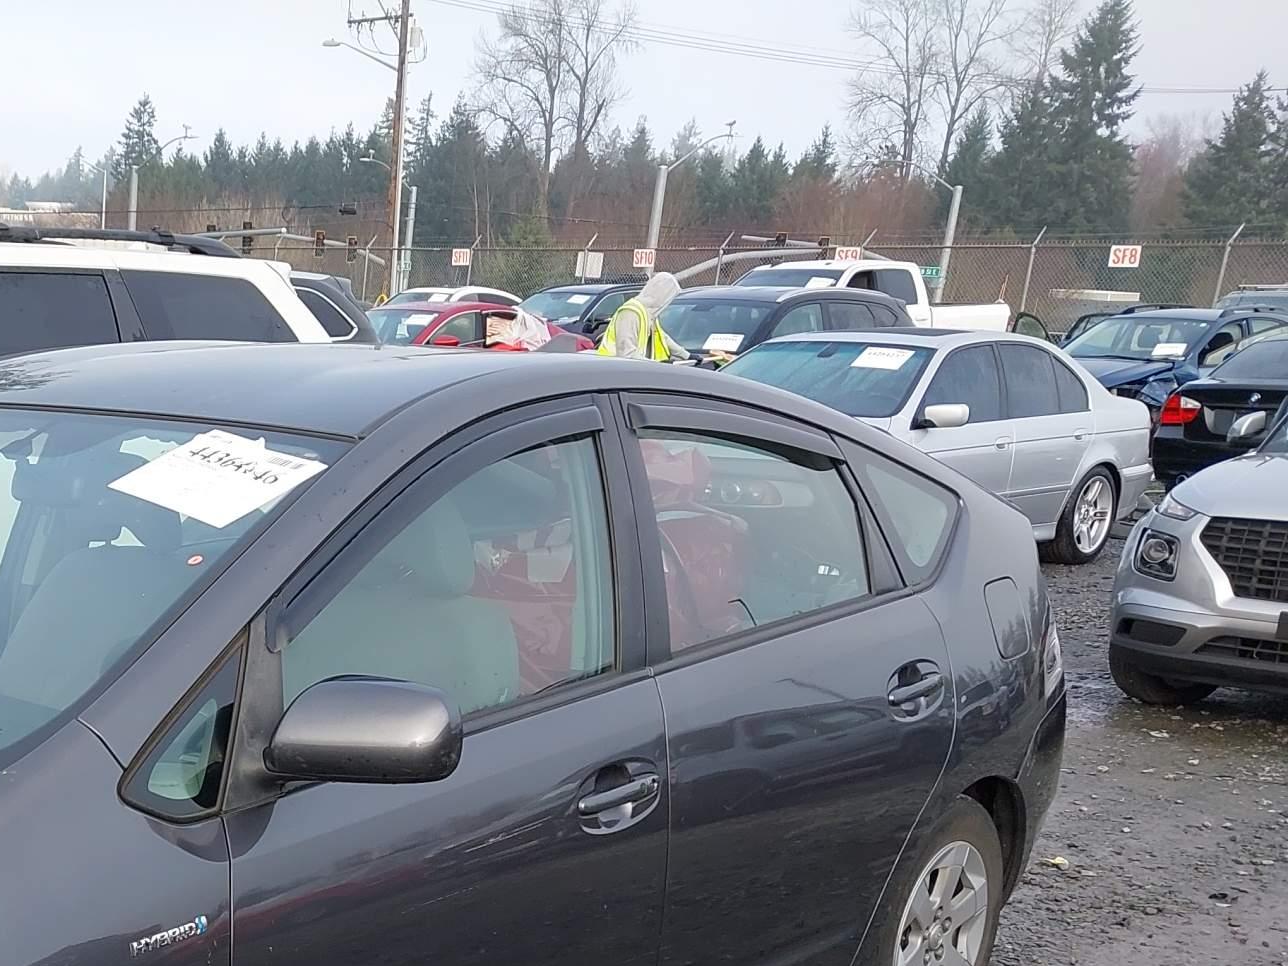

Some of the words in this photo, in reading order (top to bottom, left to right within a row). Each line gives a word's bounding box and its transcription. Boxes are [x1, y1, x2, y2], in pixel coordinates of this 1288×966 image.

[454, 250, 468, 263] SF11
[634, 250, 653, 265] SF10
[1112, 247, 1138, 265] SF8
[129, 922, 196, 957] HYBRID
